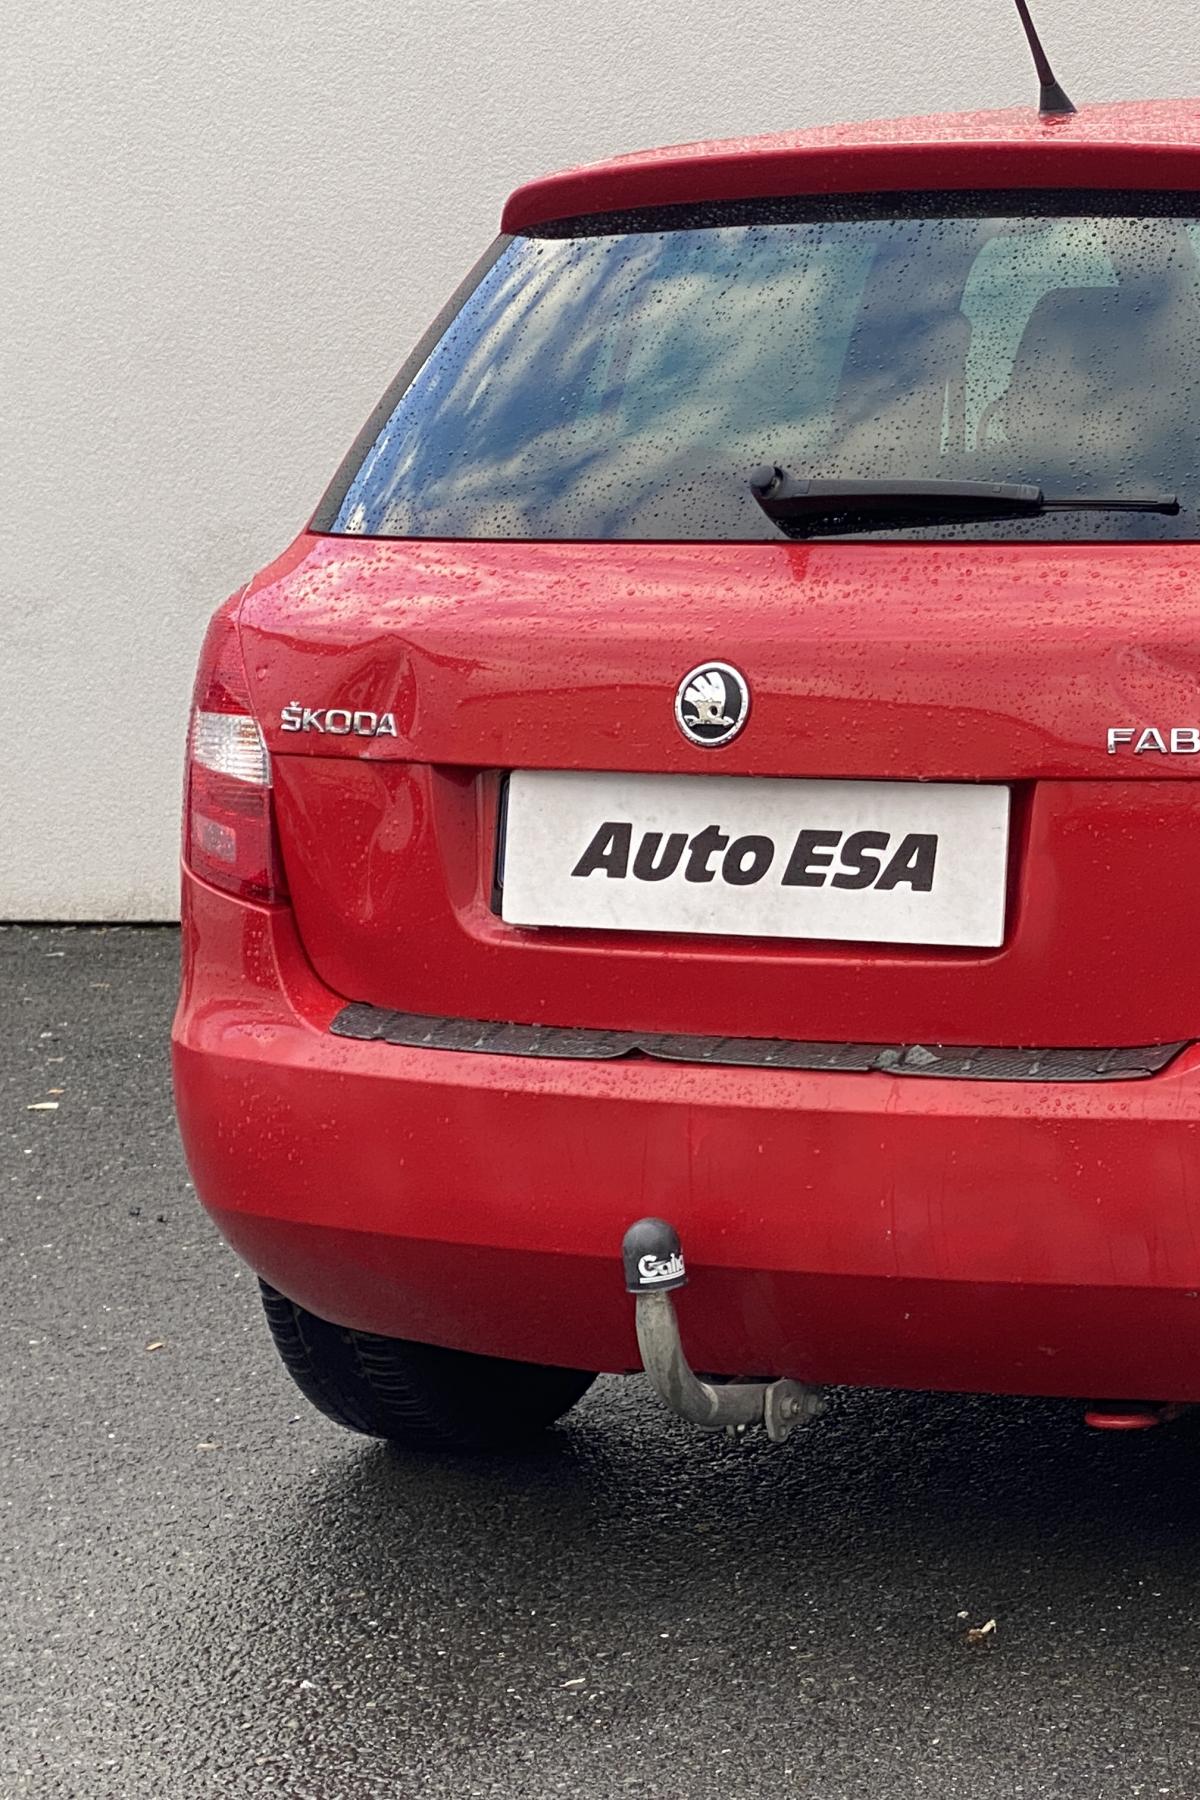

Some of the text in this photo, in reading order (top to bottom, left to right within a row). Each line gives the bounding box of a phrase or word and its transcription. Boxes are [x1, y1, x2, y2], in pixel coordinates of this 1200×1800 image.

[280, 700, 398, 738] ŠKODA
[570, 821, 939, 892] Auto ESA
